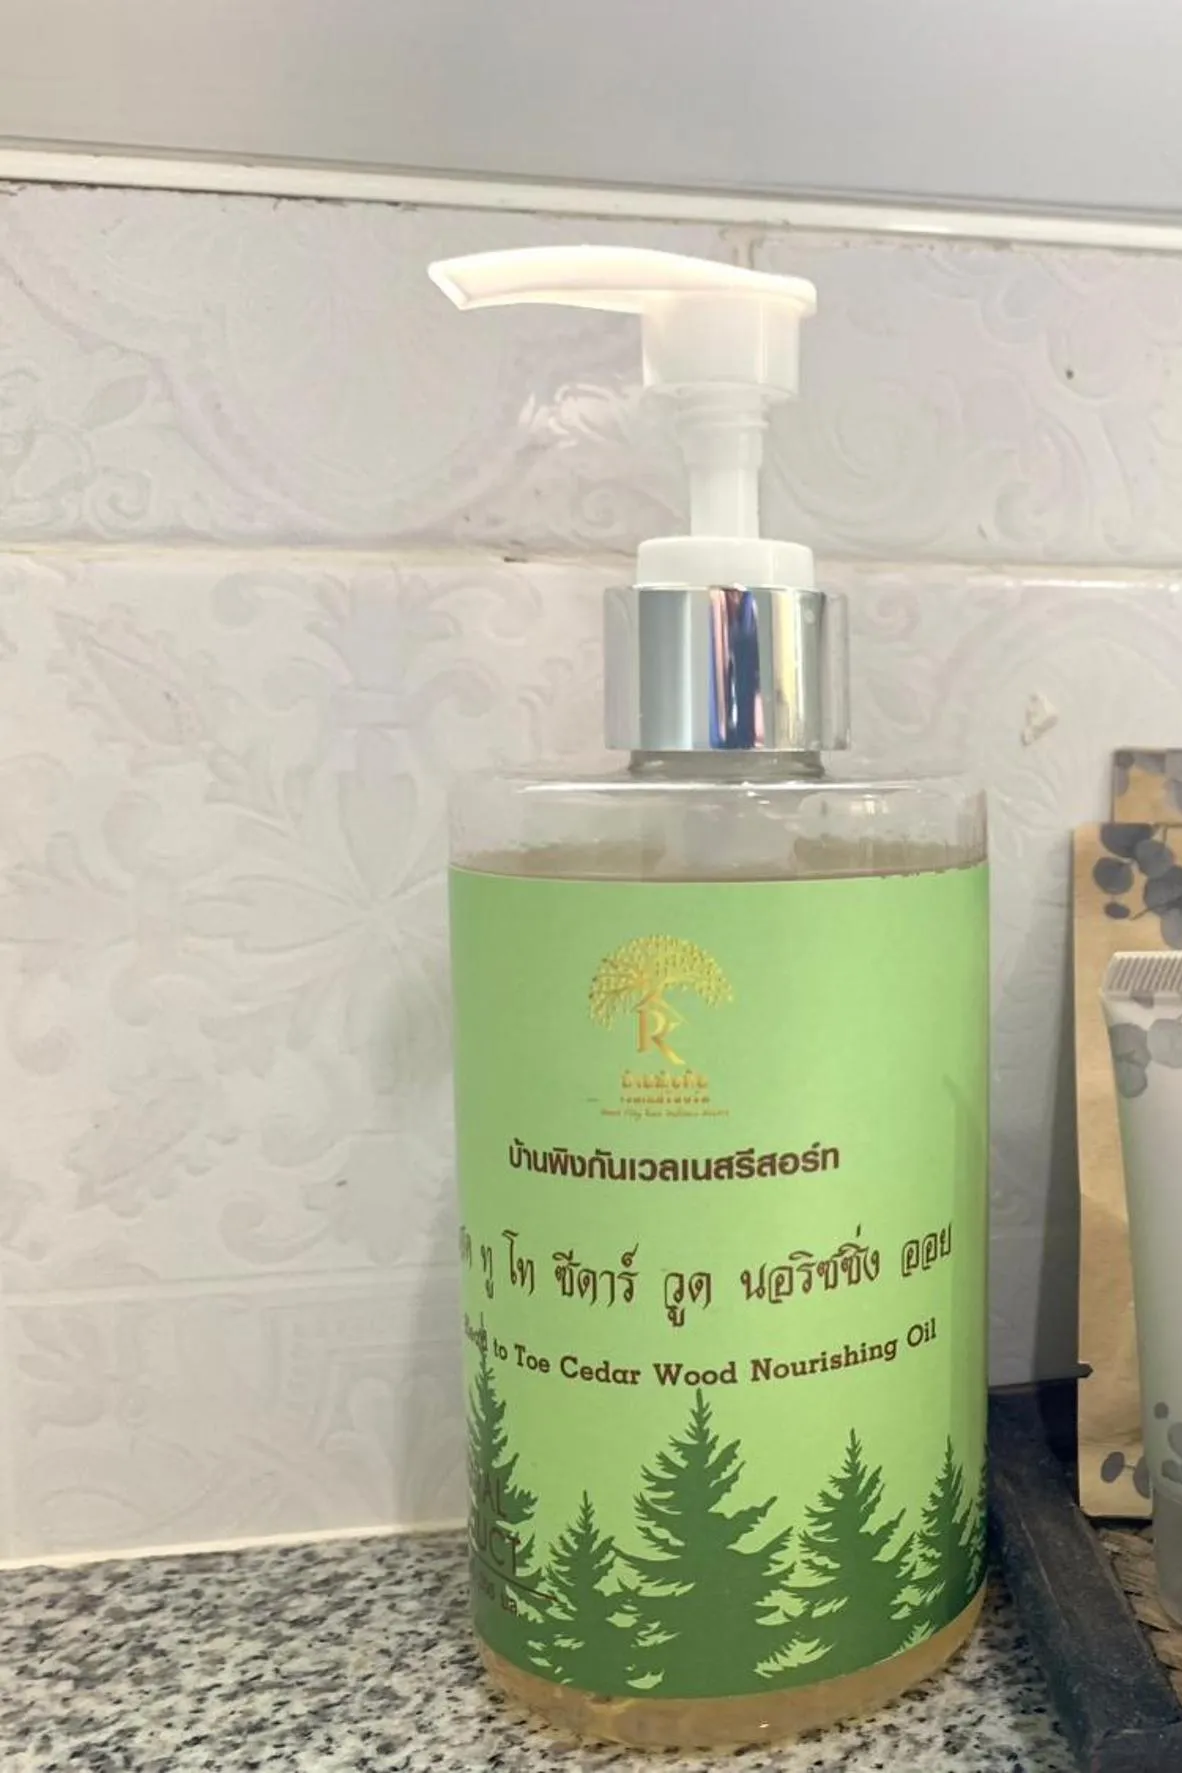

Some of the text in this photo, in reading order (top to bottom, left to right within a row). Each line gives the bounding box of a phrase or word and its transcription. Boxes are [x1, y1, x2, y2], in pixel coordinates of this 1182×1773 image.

[508, 1137, 840, 1182] บ้านพิงกันเวลเนสรีสอร์ท
[502, 1229, 534, 1295] โท
[552, 1241, 640, 1308] ซีดาร์
[664, 1271, 712, 1327] วูด
[901, 1222, 952, 1277] ออย
[493, 1318, 936, 1387] to Toe Cedar Wood Nourishing Oil
